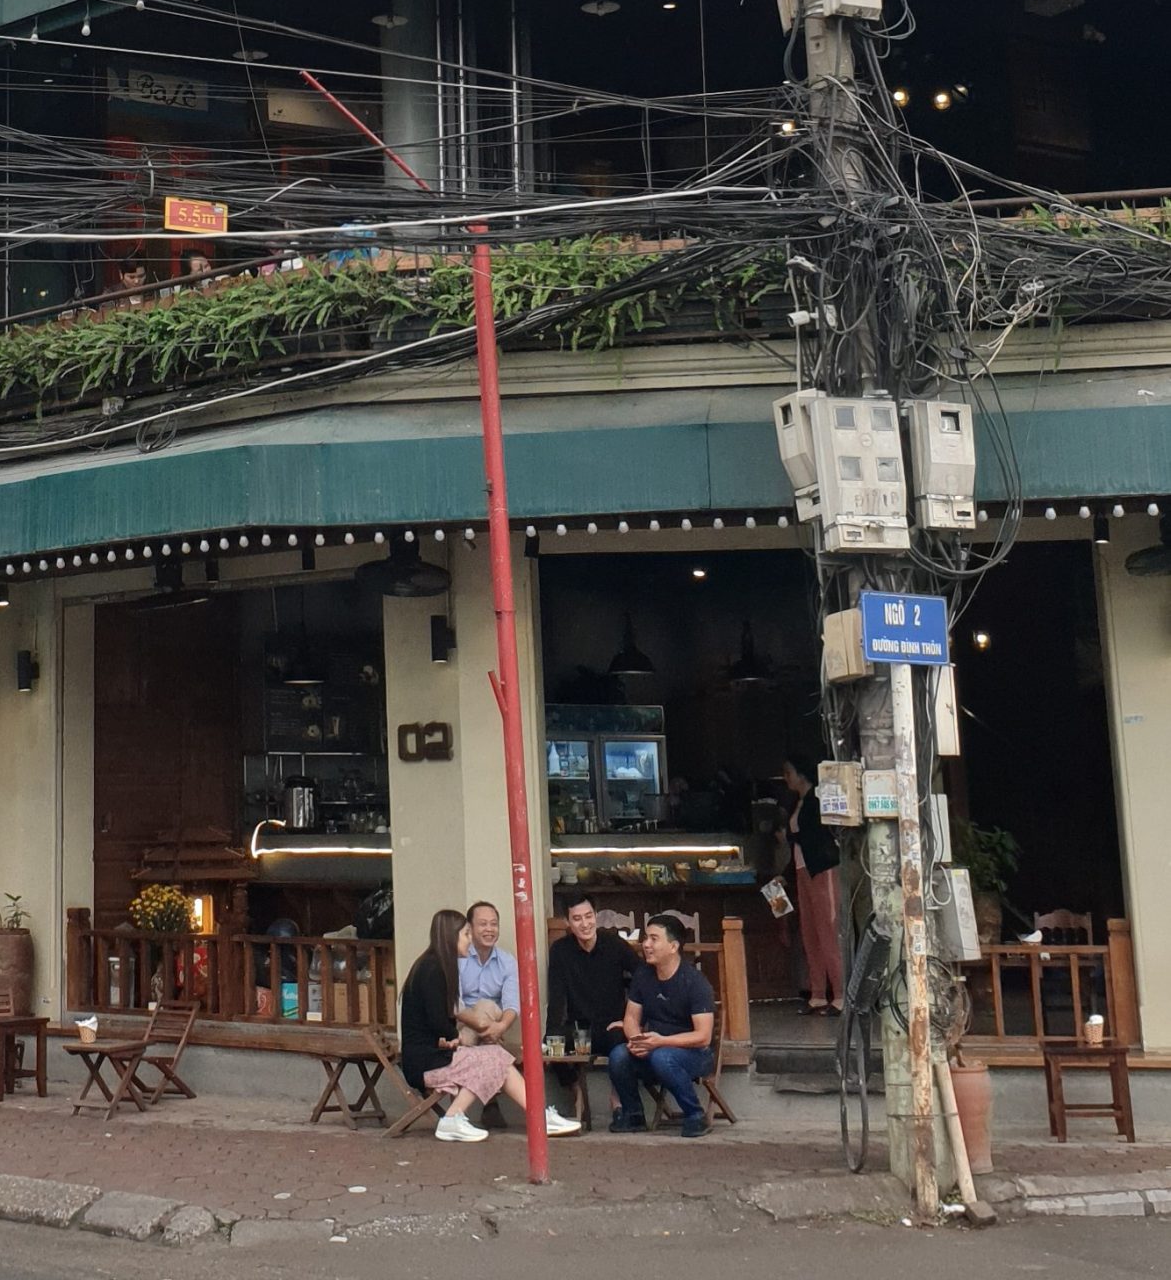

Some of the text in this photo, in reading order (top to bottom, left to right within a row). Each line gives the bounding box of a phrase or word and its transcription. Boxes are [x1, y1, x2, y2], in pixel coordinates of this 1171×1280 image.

[884, 599, 921, 626] NGÕ 2
[872, 636, 899, 653] ĐƯỜNG
[900, 637, 920, 654] ĐÌNH
[398, 721, 453, 762] 02
